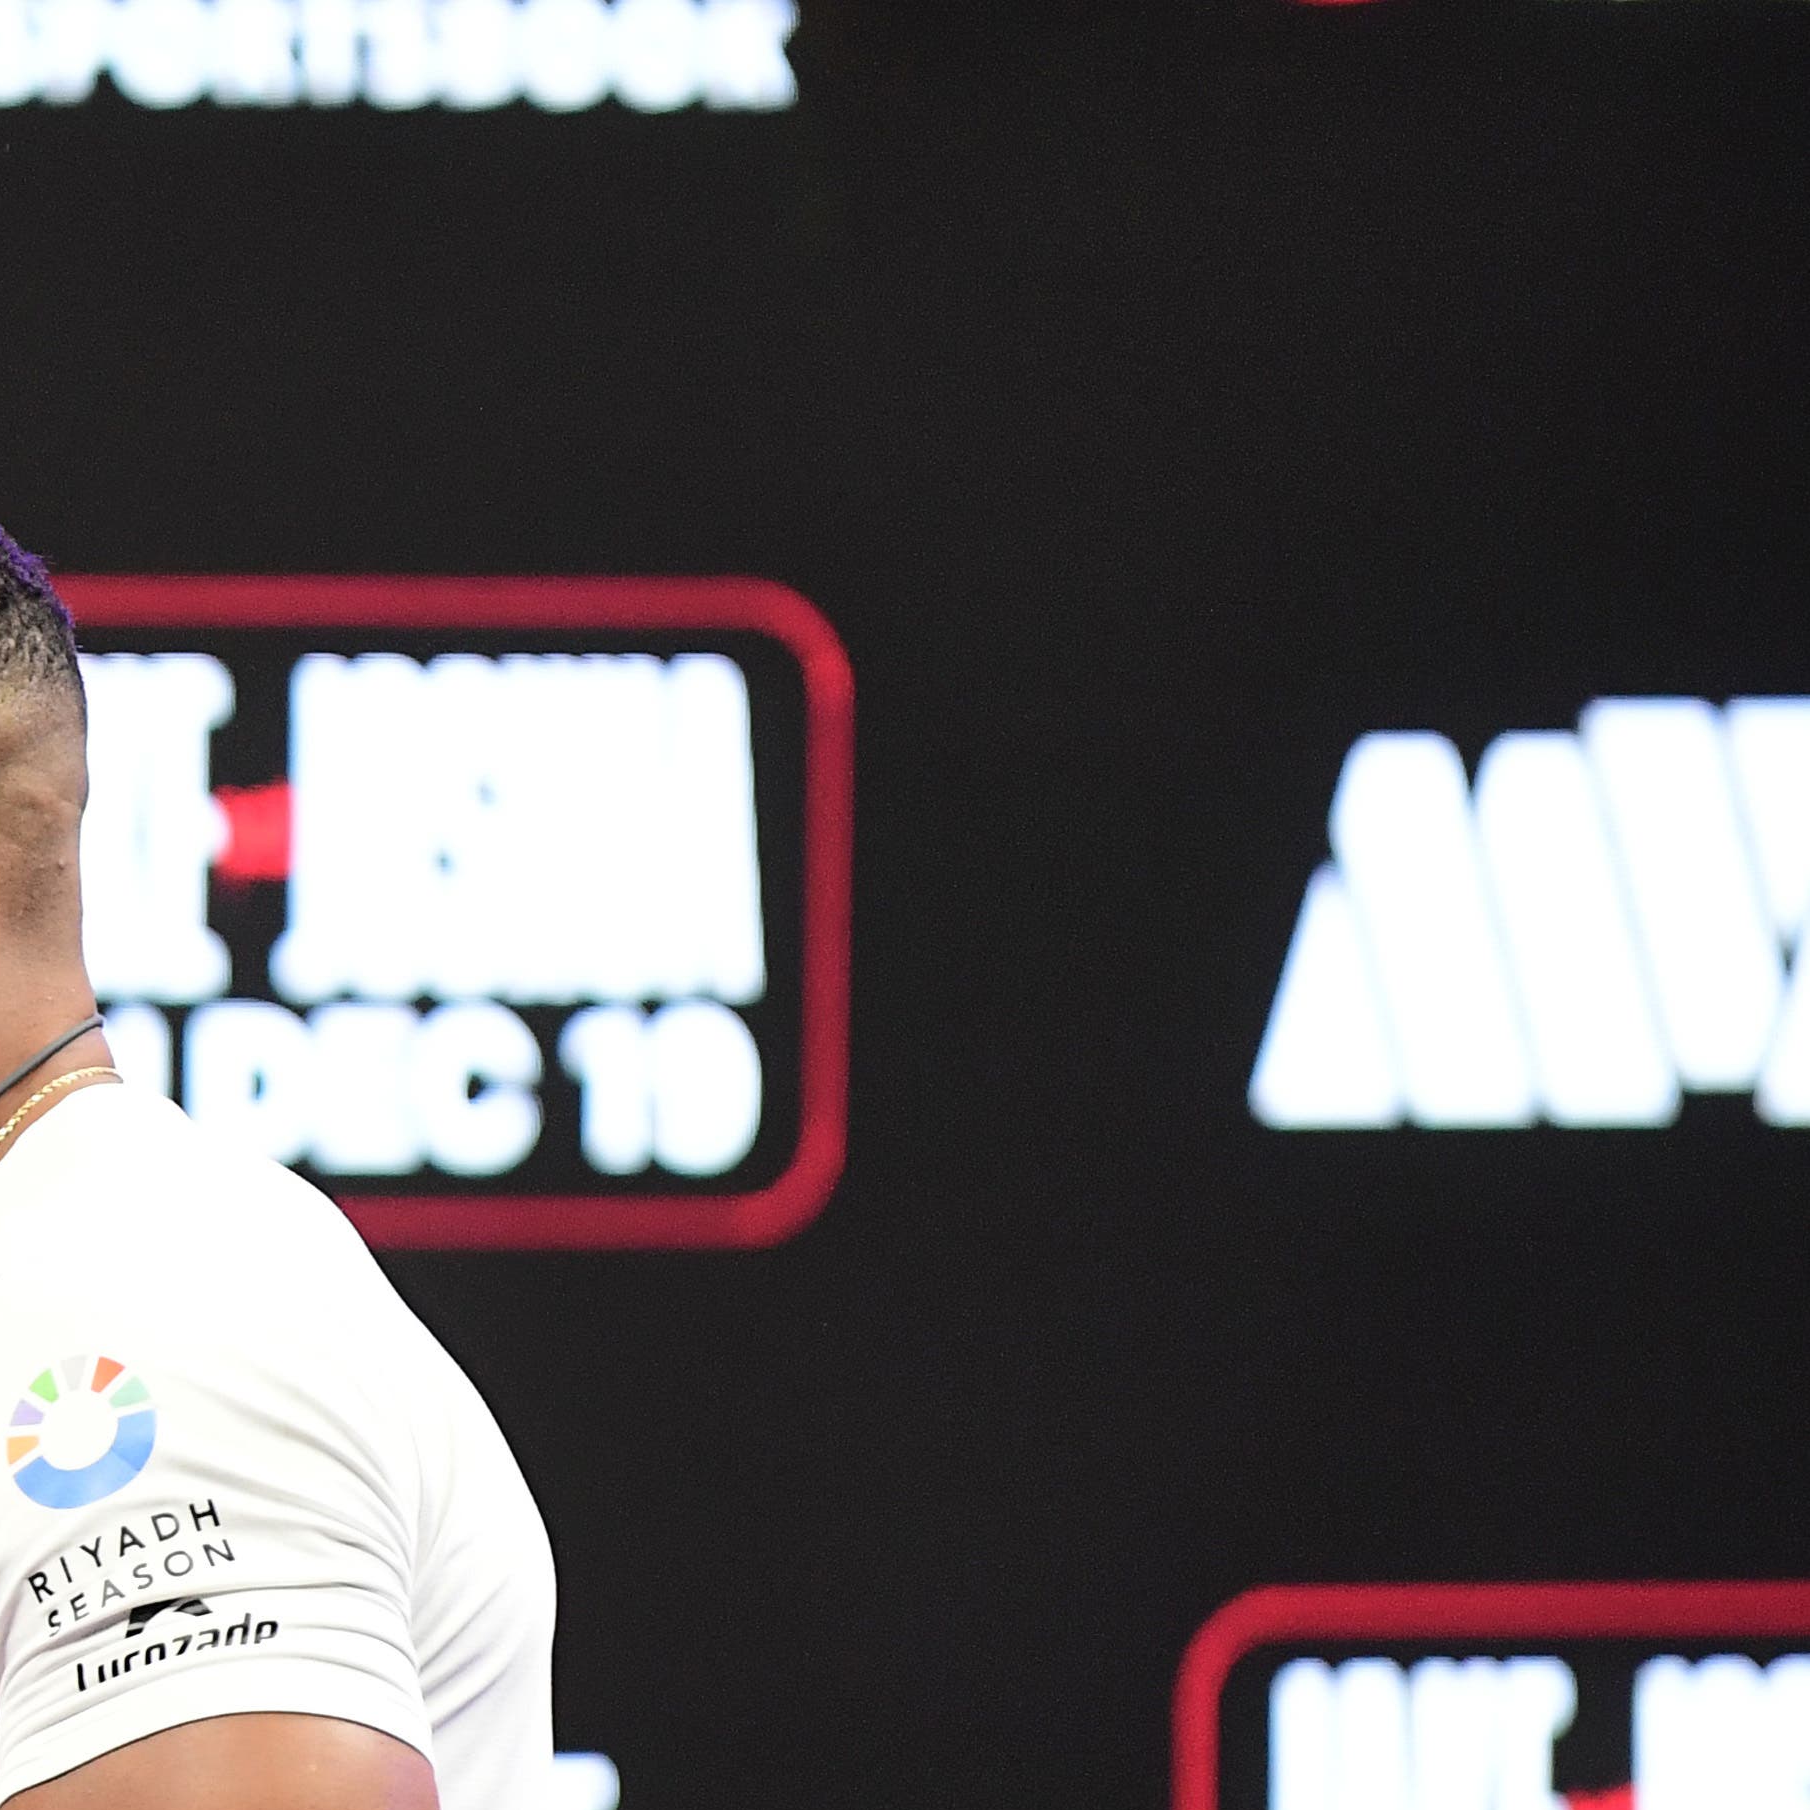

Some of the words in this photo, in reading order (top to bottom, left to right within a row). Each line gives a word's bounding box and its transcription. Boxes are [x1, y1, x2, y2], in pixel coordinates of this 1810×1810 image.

[1248, 697, 1810, 1131] MV
[27, 1498, 222, 1604] RIYADH
[46, 1538, 236, 1638] SEASON
